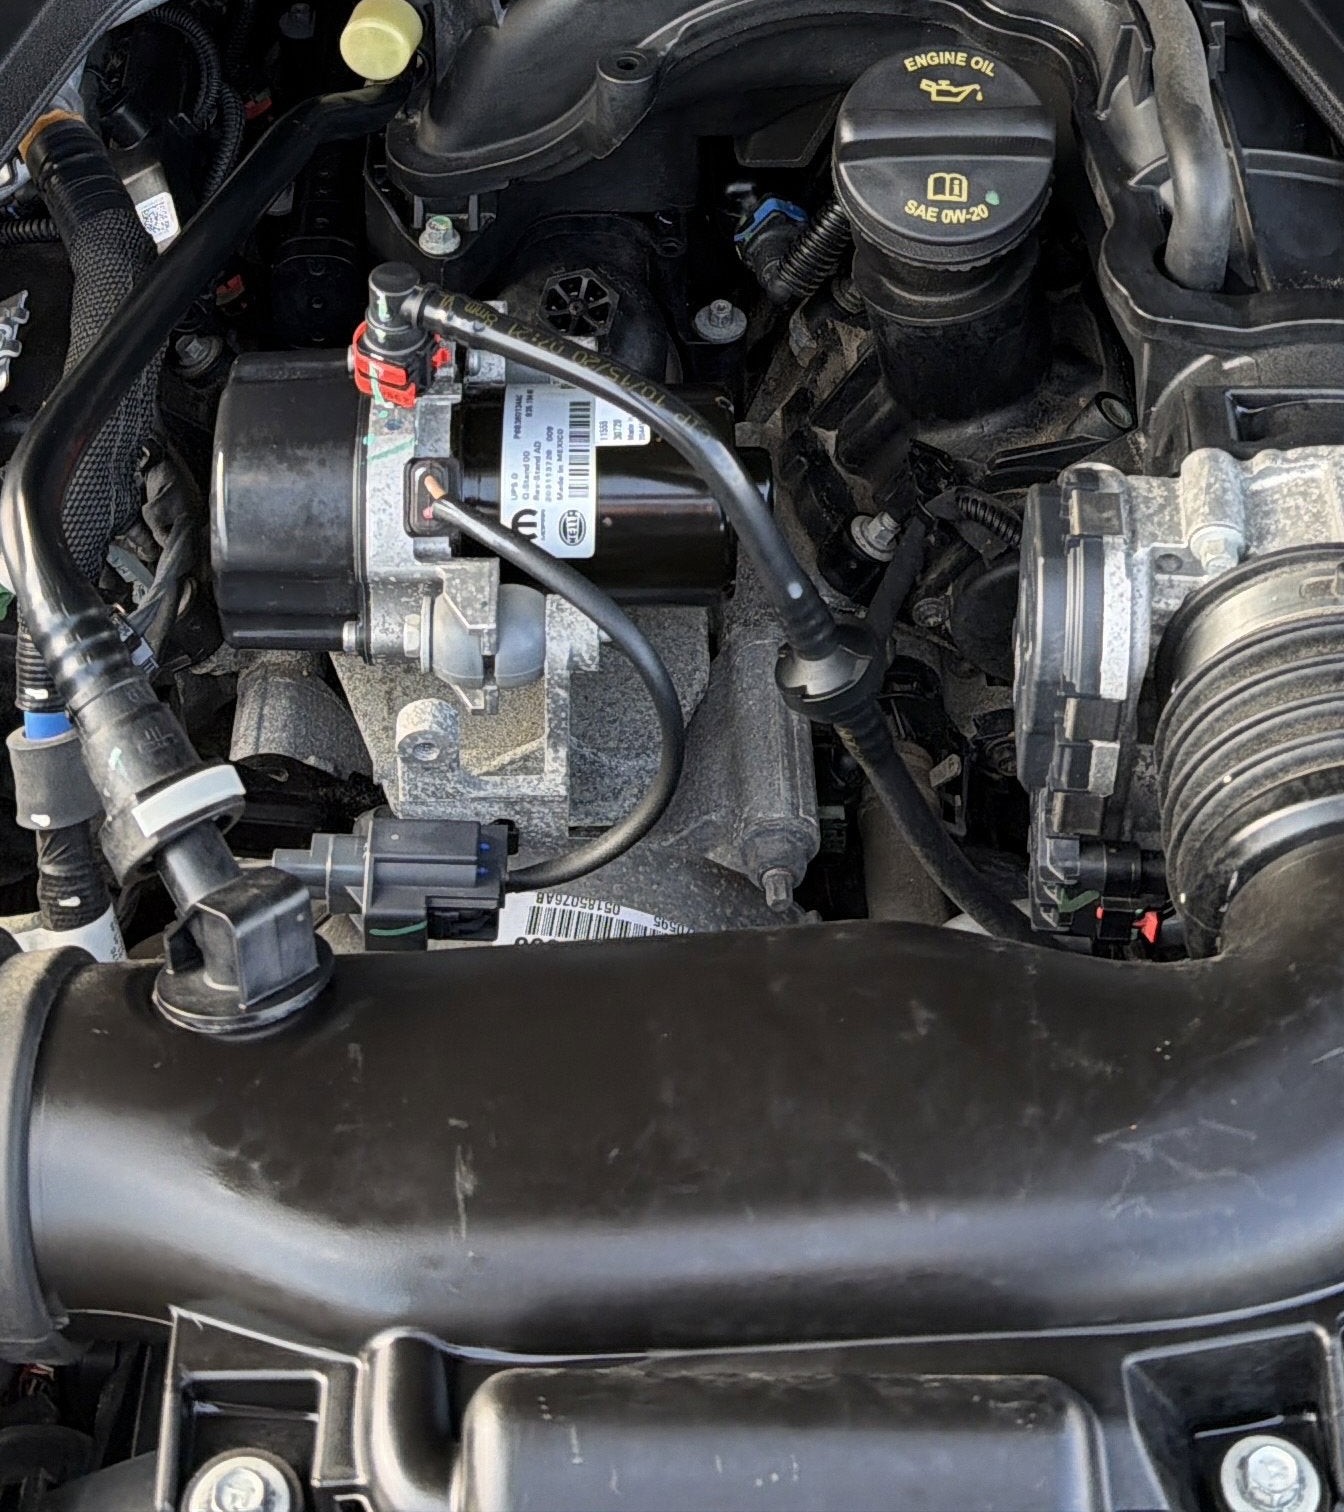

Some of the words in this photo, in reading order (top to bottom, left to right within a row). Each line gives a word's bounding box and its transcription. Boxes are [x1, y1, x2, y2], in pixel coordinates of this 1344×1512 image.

[904, 51, 967, 72] ENGINE
[970, 56, 995, 77] OIL
[905, 199, 938, 222] SAE
[941, 203, 989, 224] 0W-20
[556, 428, 564, 462] MEXICO
